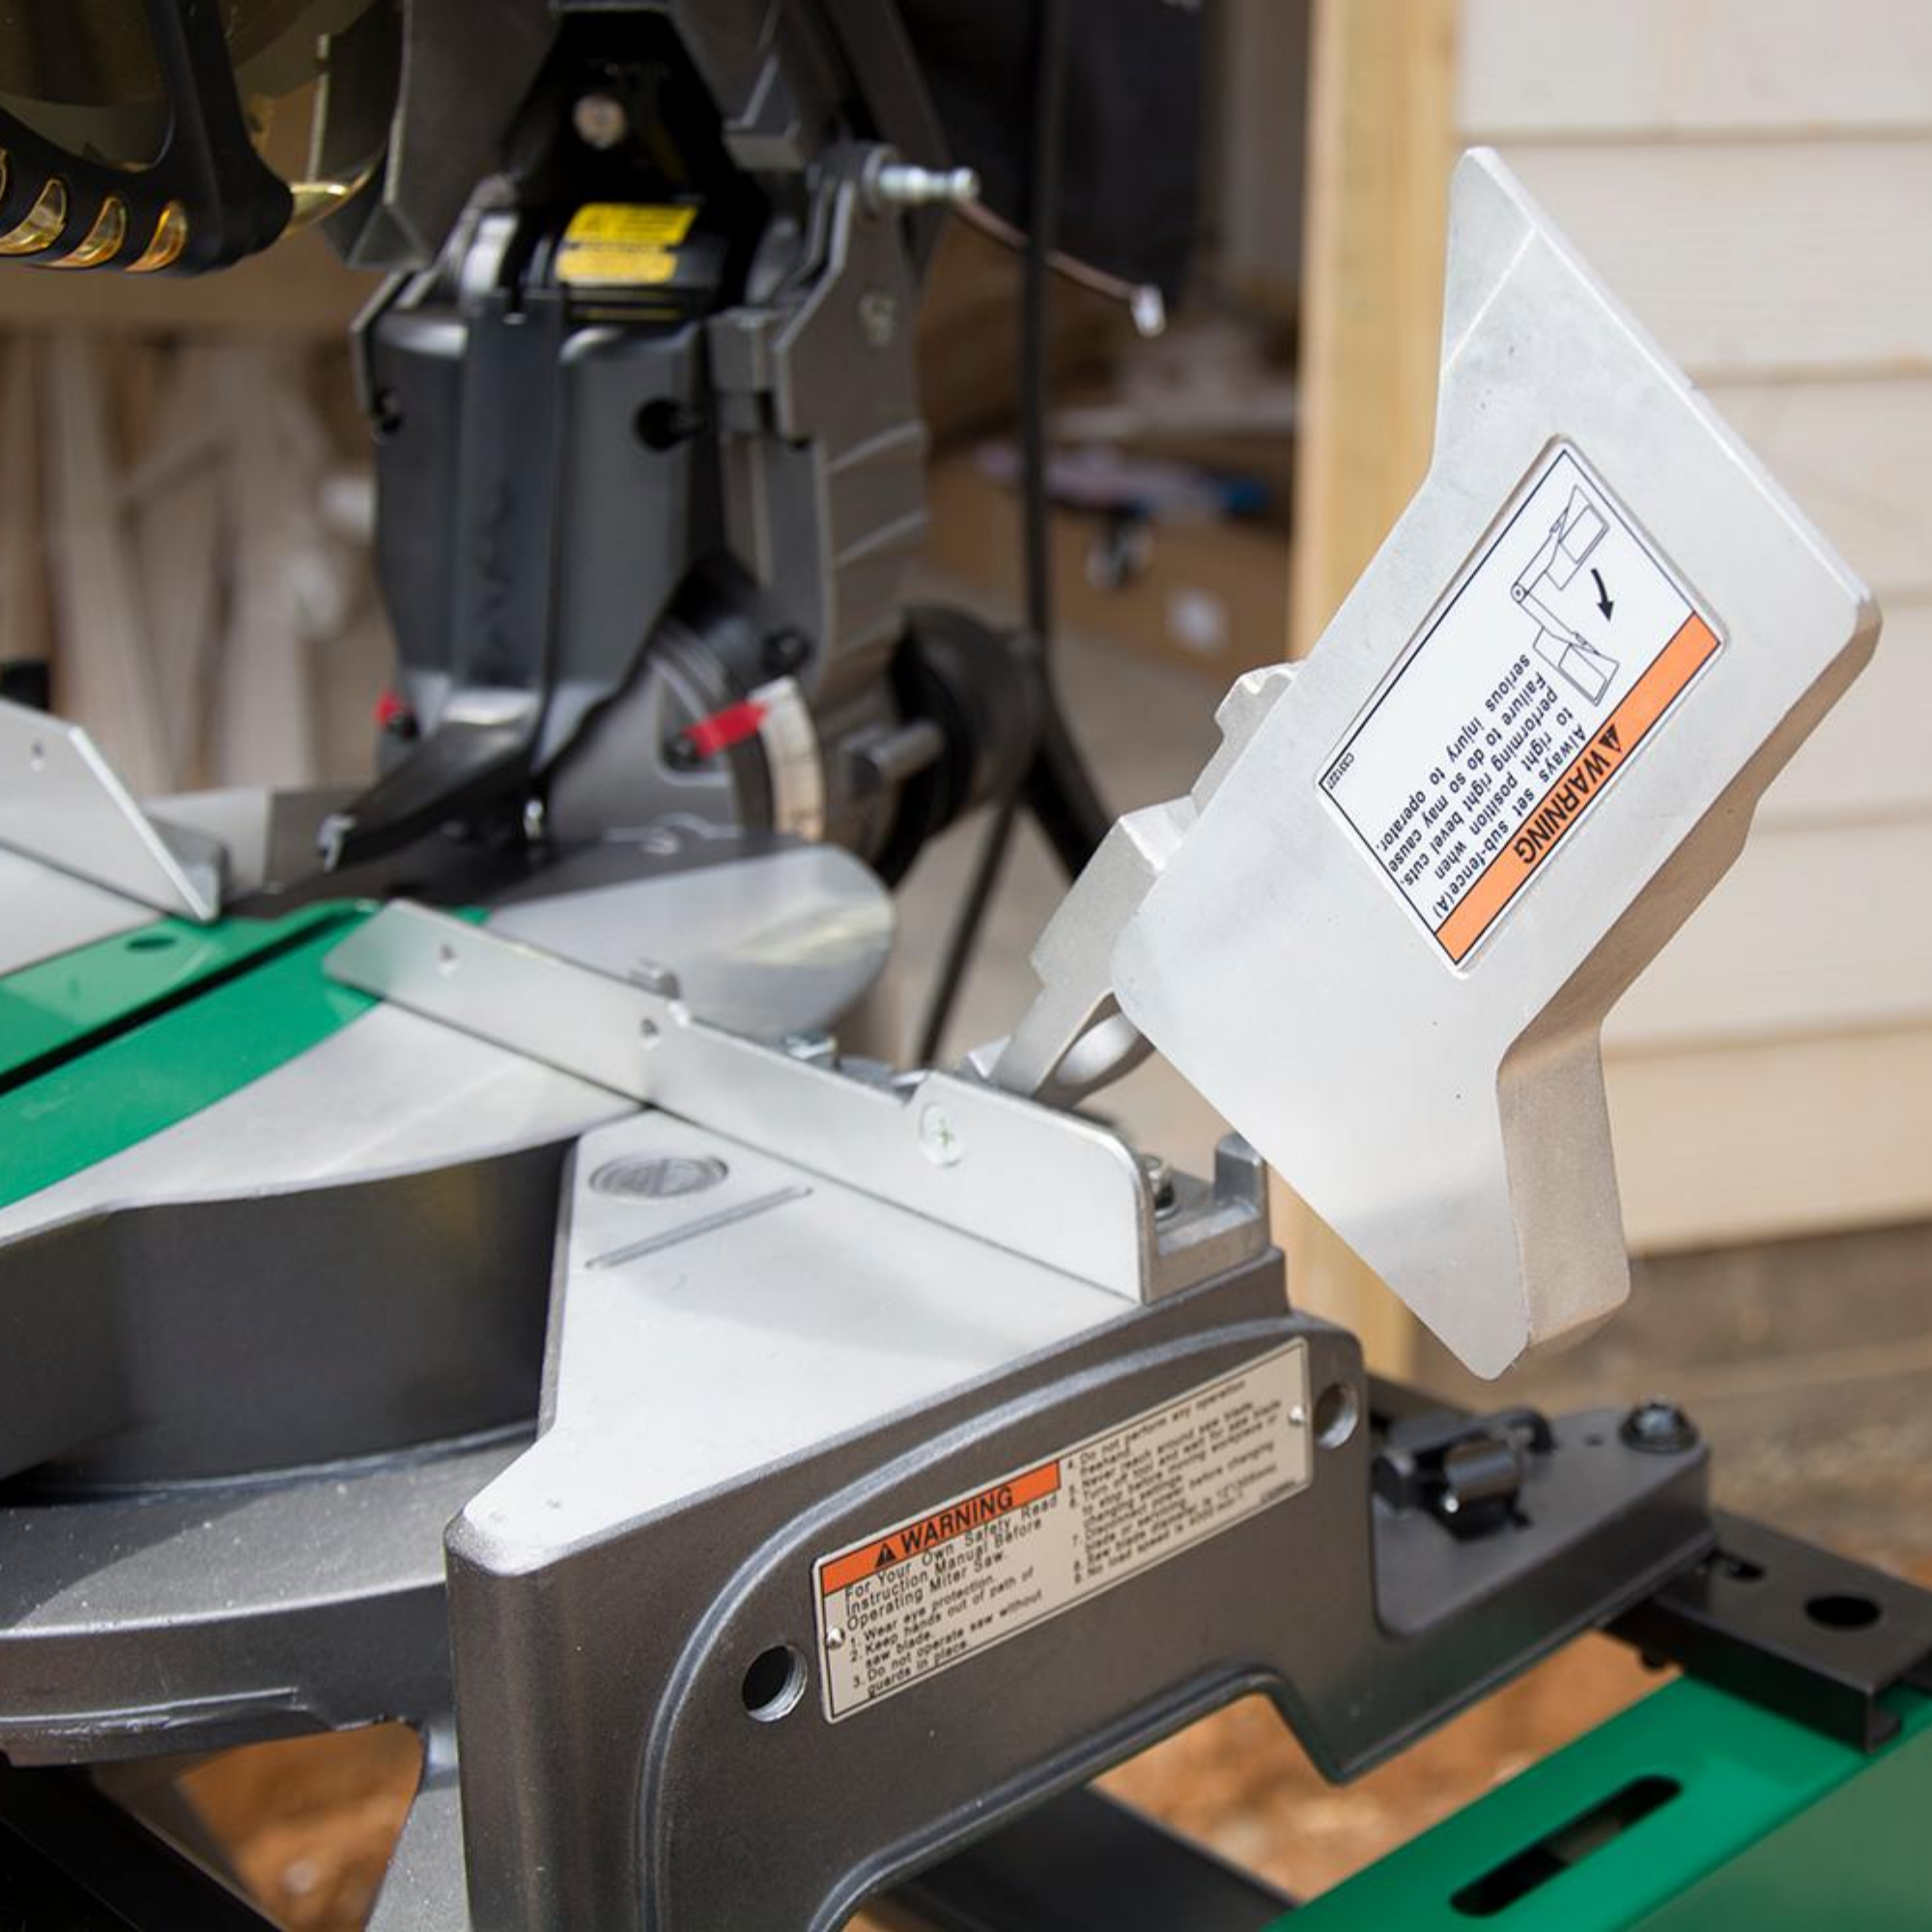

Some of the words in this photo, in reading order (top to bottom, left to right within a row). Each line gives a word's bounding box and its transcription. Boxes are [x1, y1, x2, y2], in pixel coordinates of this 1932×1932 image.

[1484, 654, 1530, 712] serious
[1501, 671, 1547, 725] Failure
[1485, 727, 1502, 747] to
[1490, 685, 1558, 772] performing
[1555, 706, 1574, 726] to
[1446, 716, 1485, 763] injury
[1466, 748, 1485, 771] do
[1520, 731, 1552, 772] right
[1538, 724, 1586, 783] Always
[1429, 766, 1445, 785] to
[1449, 772, 1466, 794] so
[1462, 772, 1492, 812] right
[1376, 790, 1426, 851] operator.
[1421, 794, 1449, 829] may
[1468, 771, 1519, 836] position
[1511, 787, 1534, 817] set
[1513, 749, 1611, 864] WARNING
[1388, 828, 1422, 872] cause
[1430, 810, 1464, 855] bevel
[1400, 852, 1430, 886] cuts.
[1433, 820, 1509, 919] sub-fence(A)
[1434, 840, 1467, 880] when
[900, 1485, 1013, 1555] WARNING
[843, 1576, 871, 1605] For
[875, 1556, 913, 1588] Your
[921, 1536, 954, 1567] Own
[963, 1510, 1011, 1548] Safety
[1020, 1489, 1058, 1521] Read
[845, 1568, 928, 1618] Instruction
[934, 1539, 987, 1577] Manual
[993, 1515, 1041, 1548] Before
[846, 1581, 923, 1634] Operating
[929, 1564, 966, 1593] Miter
[865, 1631, 898, 1657] Keep
[903, 1610, 941, 1637] hands
[947, 1598, 967, 1616] out
[990, 1576, 1016, 1598] path
[1021, 1564, 1034, 1581] of
[864, 1618, 897, 1642] Wear
[903, 1605, 925, 1625] eye
[867, 1663, 886, 1682] Do
[891, 1650, 912, 1670] not
[916, 1627, 964, 1659] operate
[970, 1613, 993, 1633] saw
[999, 1588, 1042, 1618] without
[866, 1649, 890, 1669] saw
[867, 1665, 912, 1699] guards
